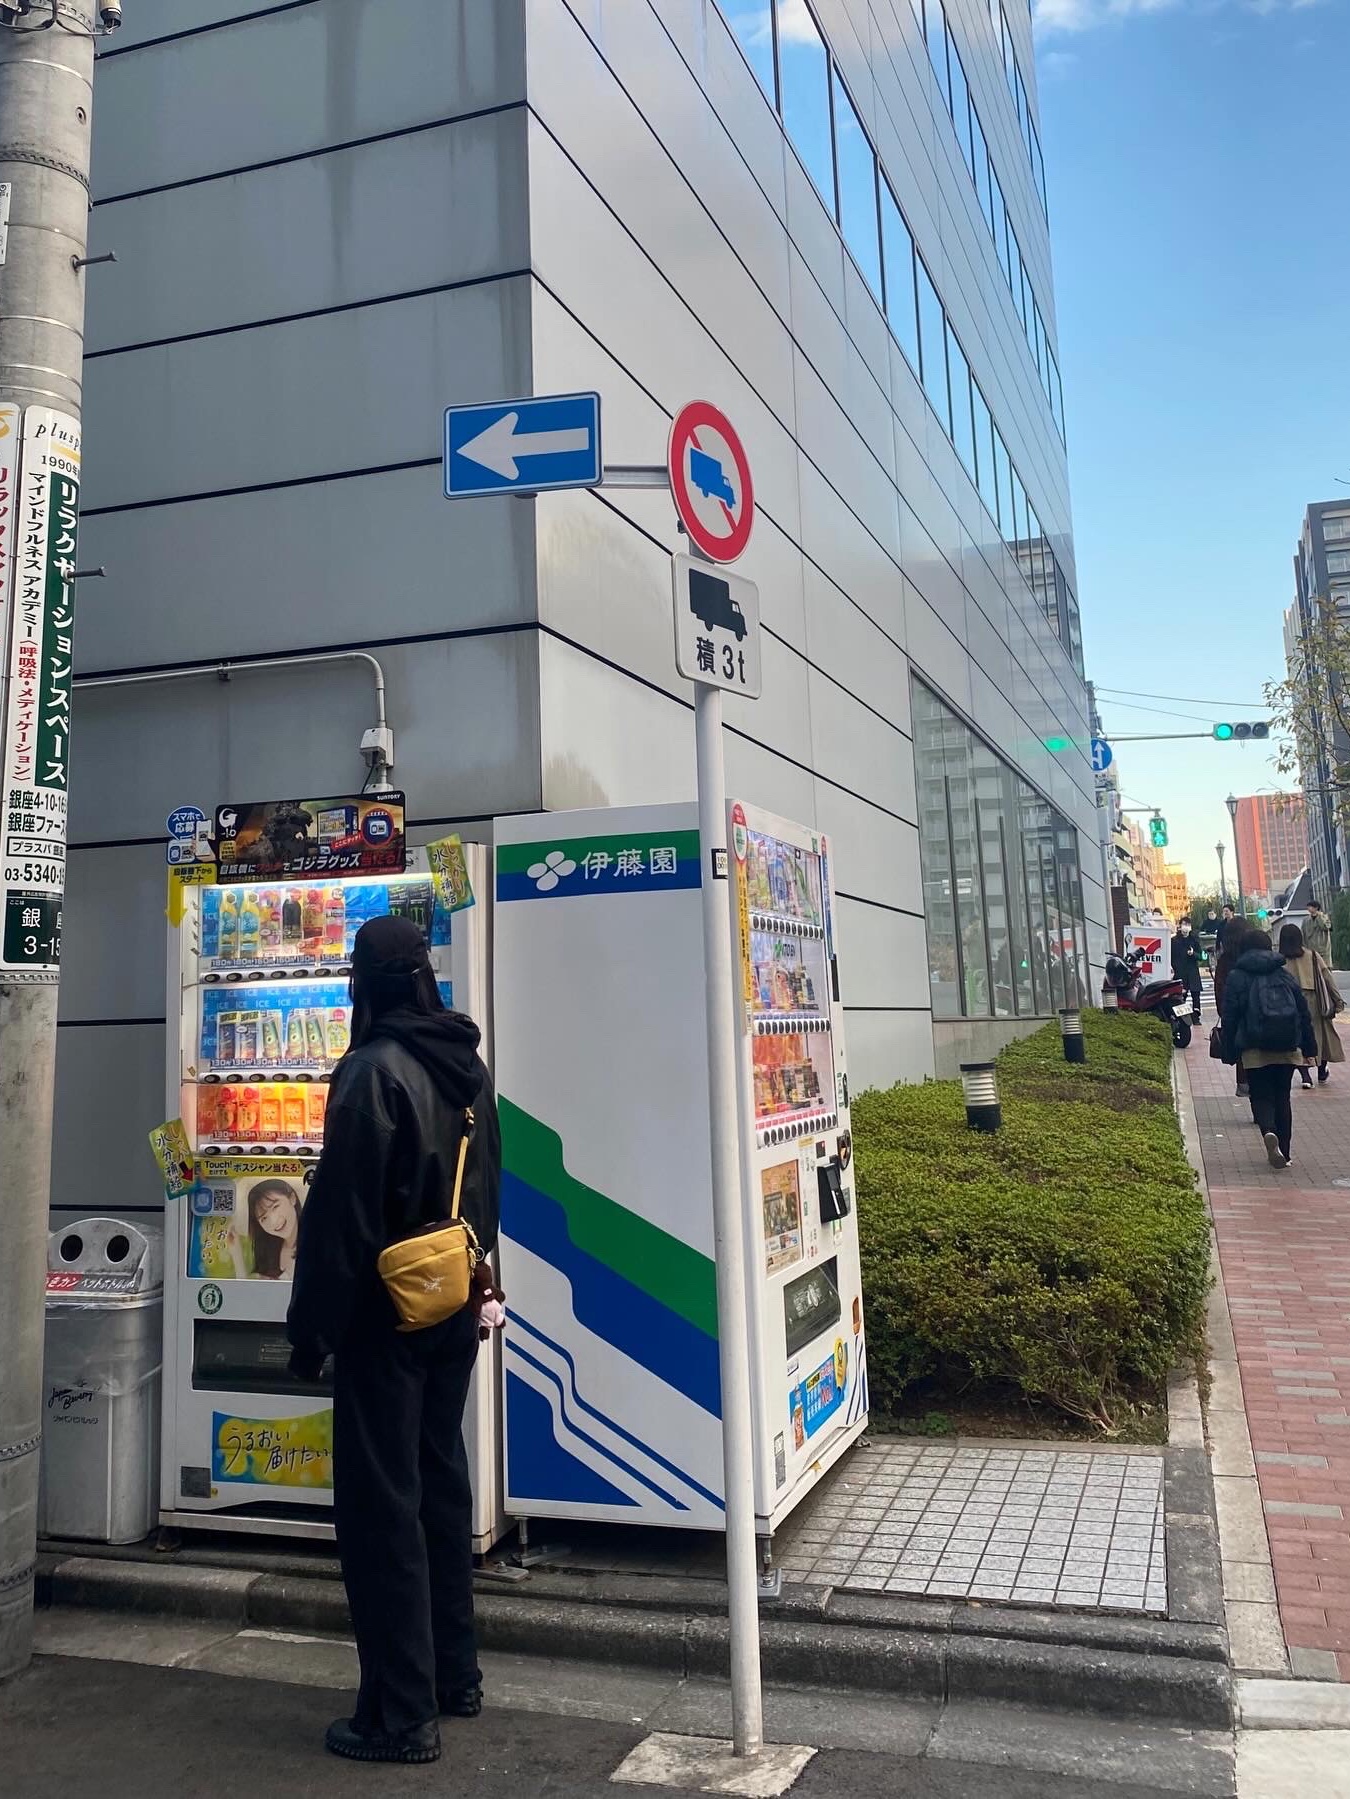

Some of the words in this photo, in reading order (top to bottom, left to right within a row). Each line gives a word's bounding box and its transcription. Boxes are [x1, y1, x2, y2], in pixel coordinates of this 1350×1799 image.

[24, 472, 47, 571] マインドフルネス
[42, 481, 77, 784] リラクゼーションスペース
[376, 793, 401, 801] SUNTORY
[172, 812, 201, 821] スマホで
[581, 847, 677, 880] 伊藤園
[179, 874, 204, 884] スタート
[204, 1160, 233, 1169] Touch!
[225, 1427, 290, 1472] うるおい
[265, 1445, 331, 1474] 届けたい
